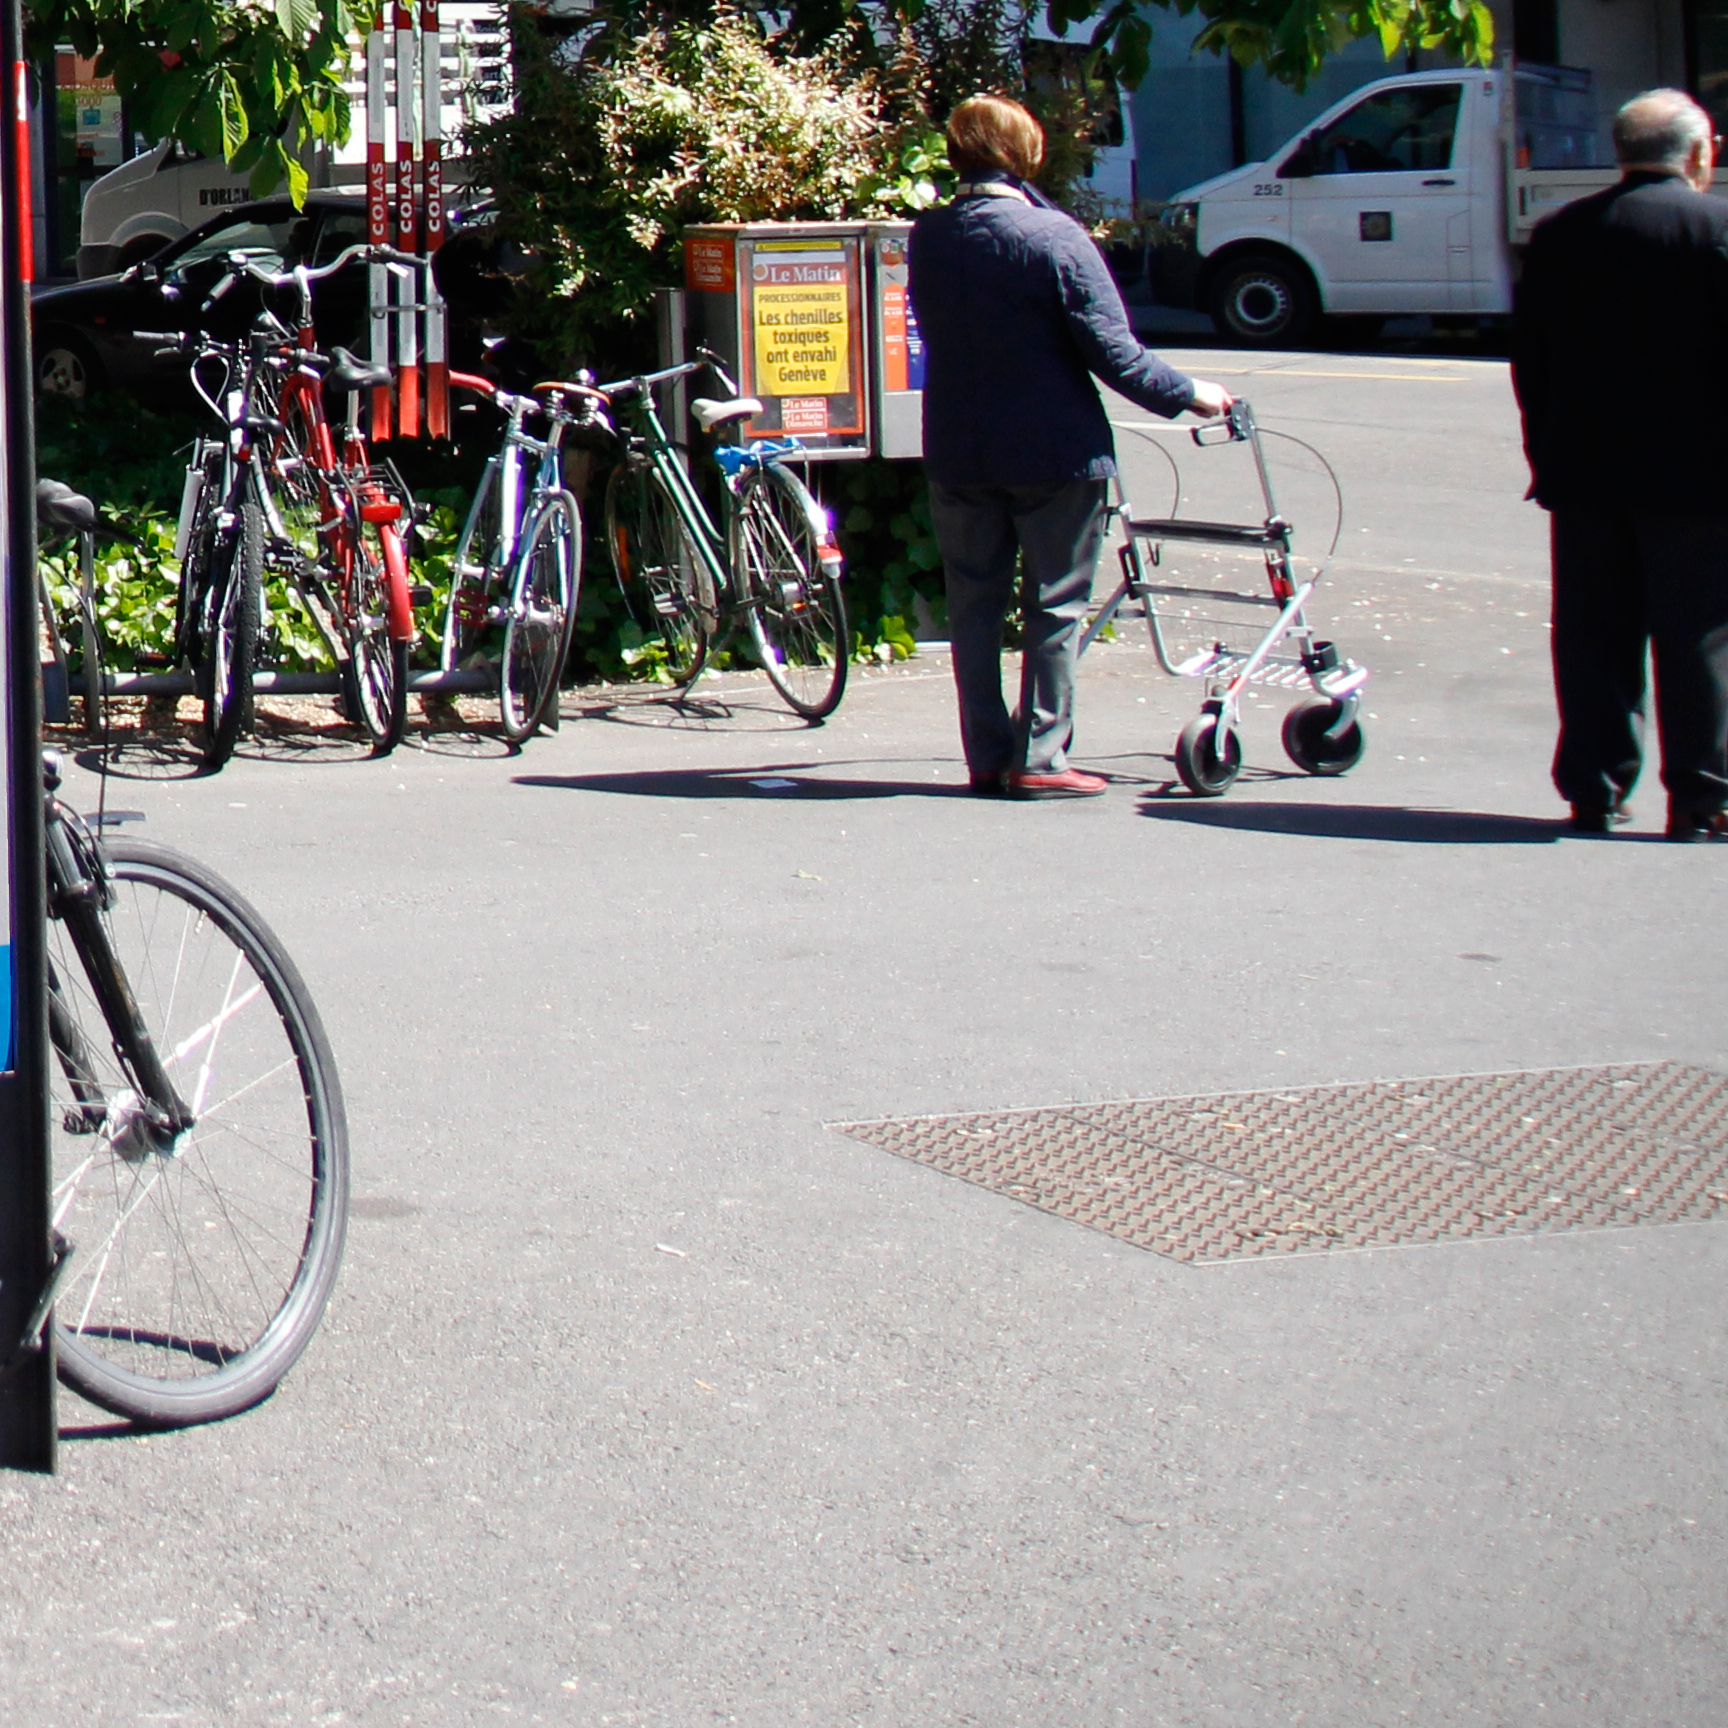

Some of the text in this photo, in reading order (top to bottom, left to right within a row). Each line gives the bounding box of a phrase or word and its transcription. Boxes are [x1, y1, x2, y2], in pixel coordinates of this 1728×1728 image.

[199, 188, 253, 205] D'ORLAN
[400, 159, 412, 234] COLAS
[428, 160, 440, 233] COLAS
[1253, 183, 1283, 196] 252
[372, 162, 384, 236] COLAS
[770, 265, 841, 282] Le Matin
[758, 292, 842, 303] PROCESSIONNAIRES
[759, 308, 843, 325] Les chenilles
[773, 329, 830, 347] toxiques
[766, 345, 837, 364] ont envahi
[778, 365, 827, 382] Genève
